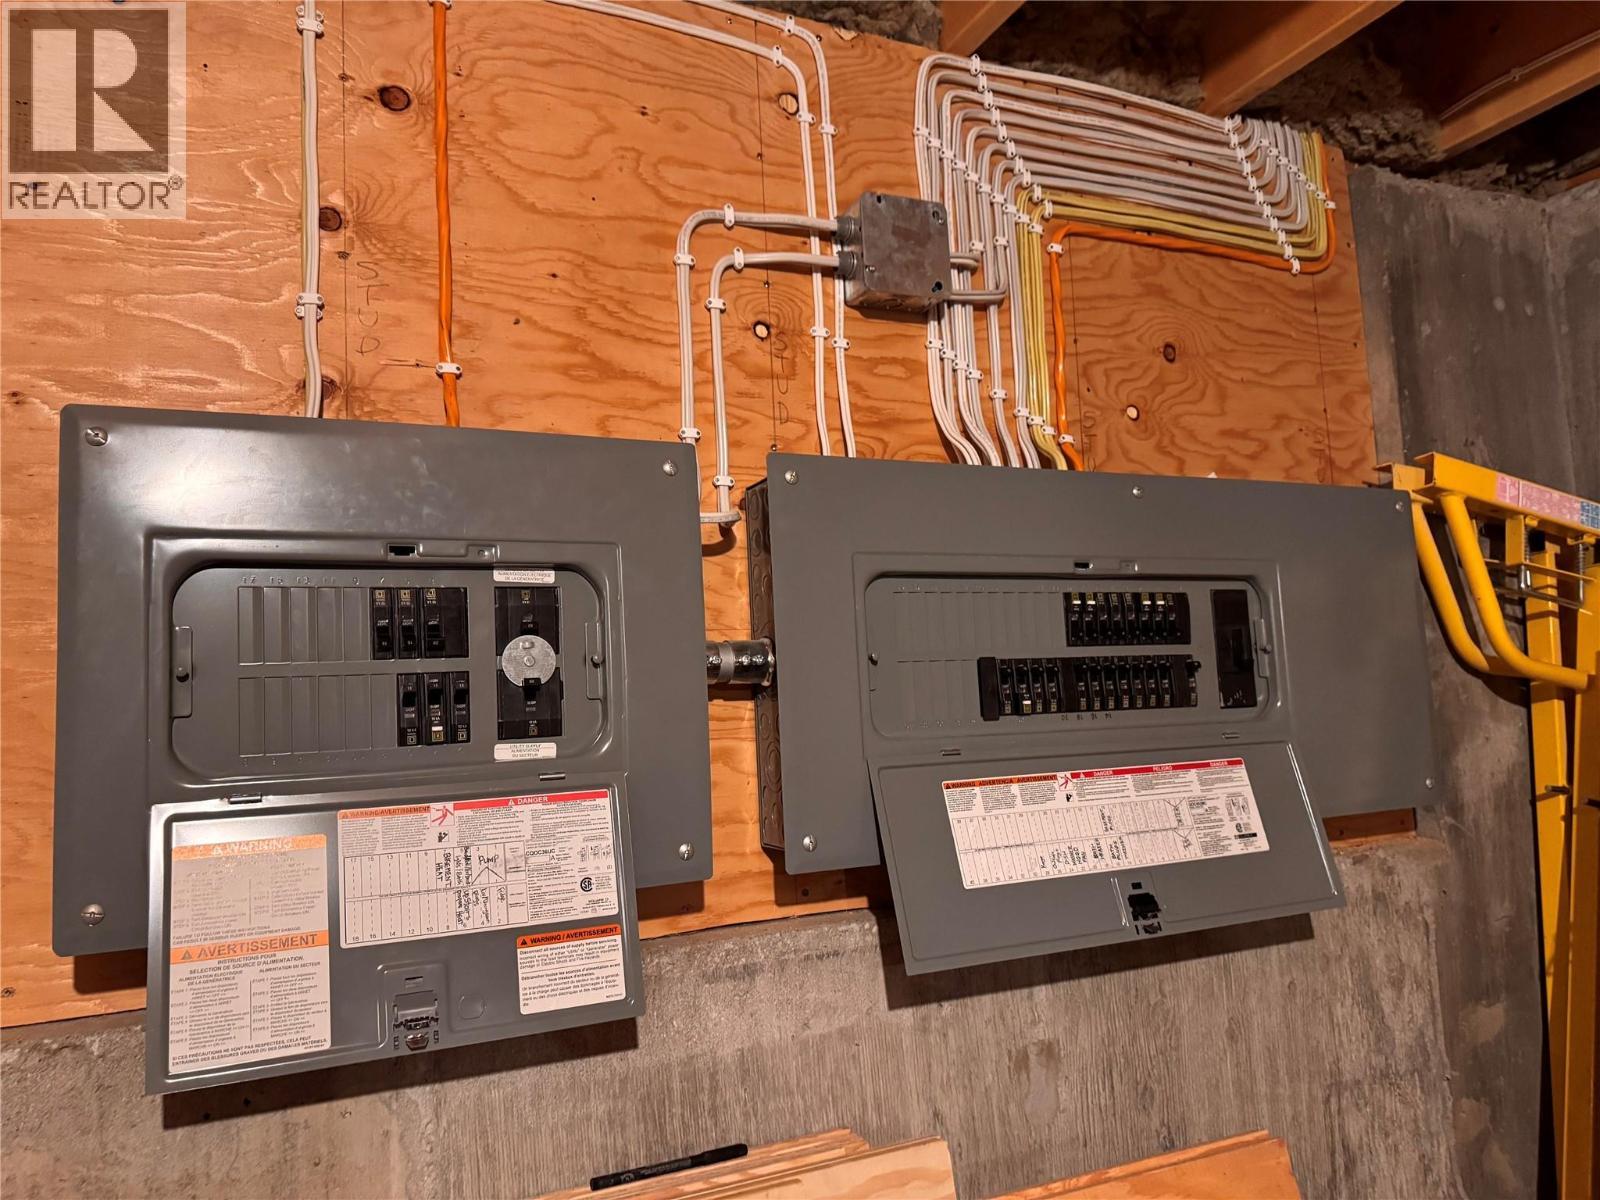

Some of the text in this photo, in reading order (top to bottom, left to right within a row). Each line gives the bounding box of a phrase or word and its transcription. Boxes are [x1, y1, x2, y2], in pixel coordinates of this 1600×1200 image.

[951, 780, 976, 788] WARNING
[517, 796, 548, 805] DANGER
[478, 854, 499, 865] PUMP
[530, 935, 561, 944] WARNING
[566, 927, 618, 939] AVERTISSEMENT
[197, 934, 318, 958] AVERTISSEMENT
